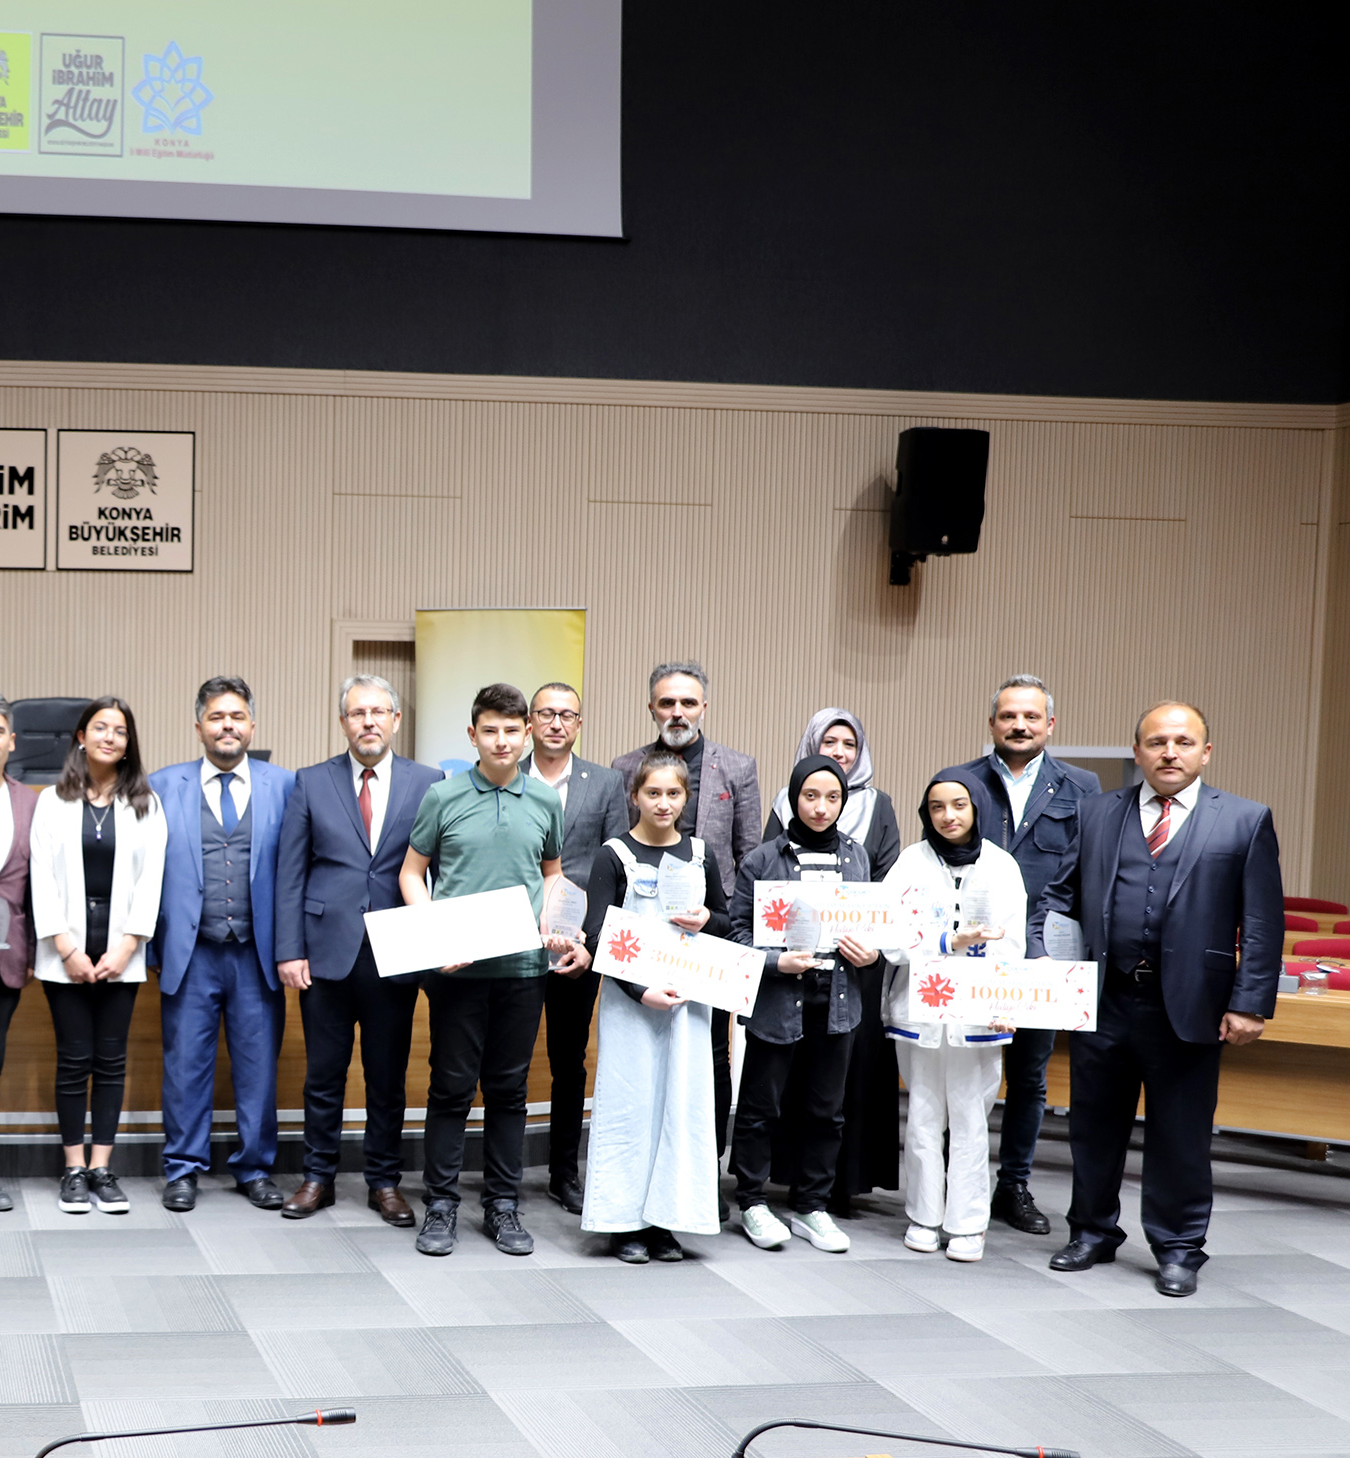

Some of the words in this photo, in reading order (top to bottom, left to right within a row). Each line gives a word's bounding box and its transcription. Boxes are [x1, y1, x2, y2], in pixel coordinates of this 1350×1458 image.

[61, 49, 104, 70] UĞUR
[45, 86, 118, 139] Altay
[154, 138, 190, 148] KONYA
[97, 507, 154, 521] KONYA
[68, 521, 182, 545] BÜYÜKŞEHİR
[91, 545, 159, 557] BELEDİYESİ
[811, 908, 862, 924] 1000
[866, 909, 894, 925] TL
[970, 985, 1024, 1001] 1000
[1028, 987, 1058, 1003] TL
